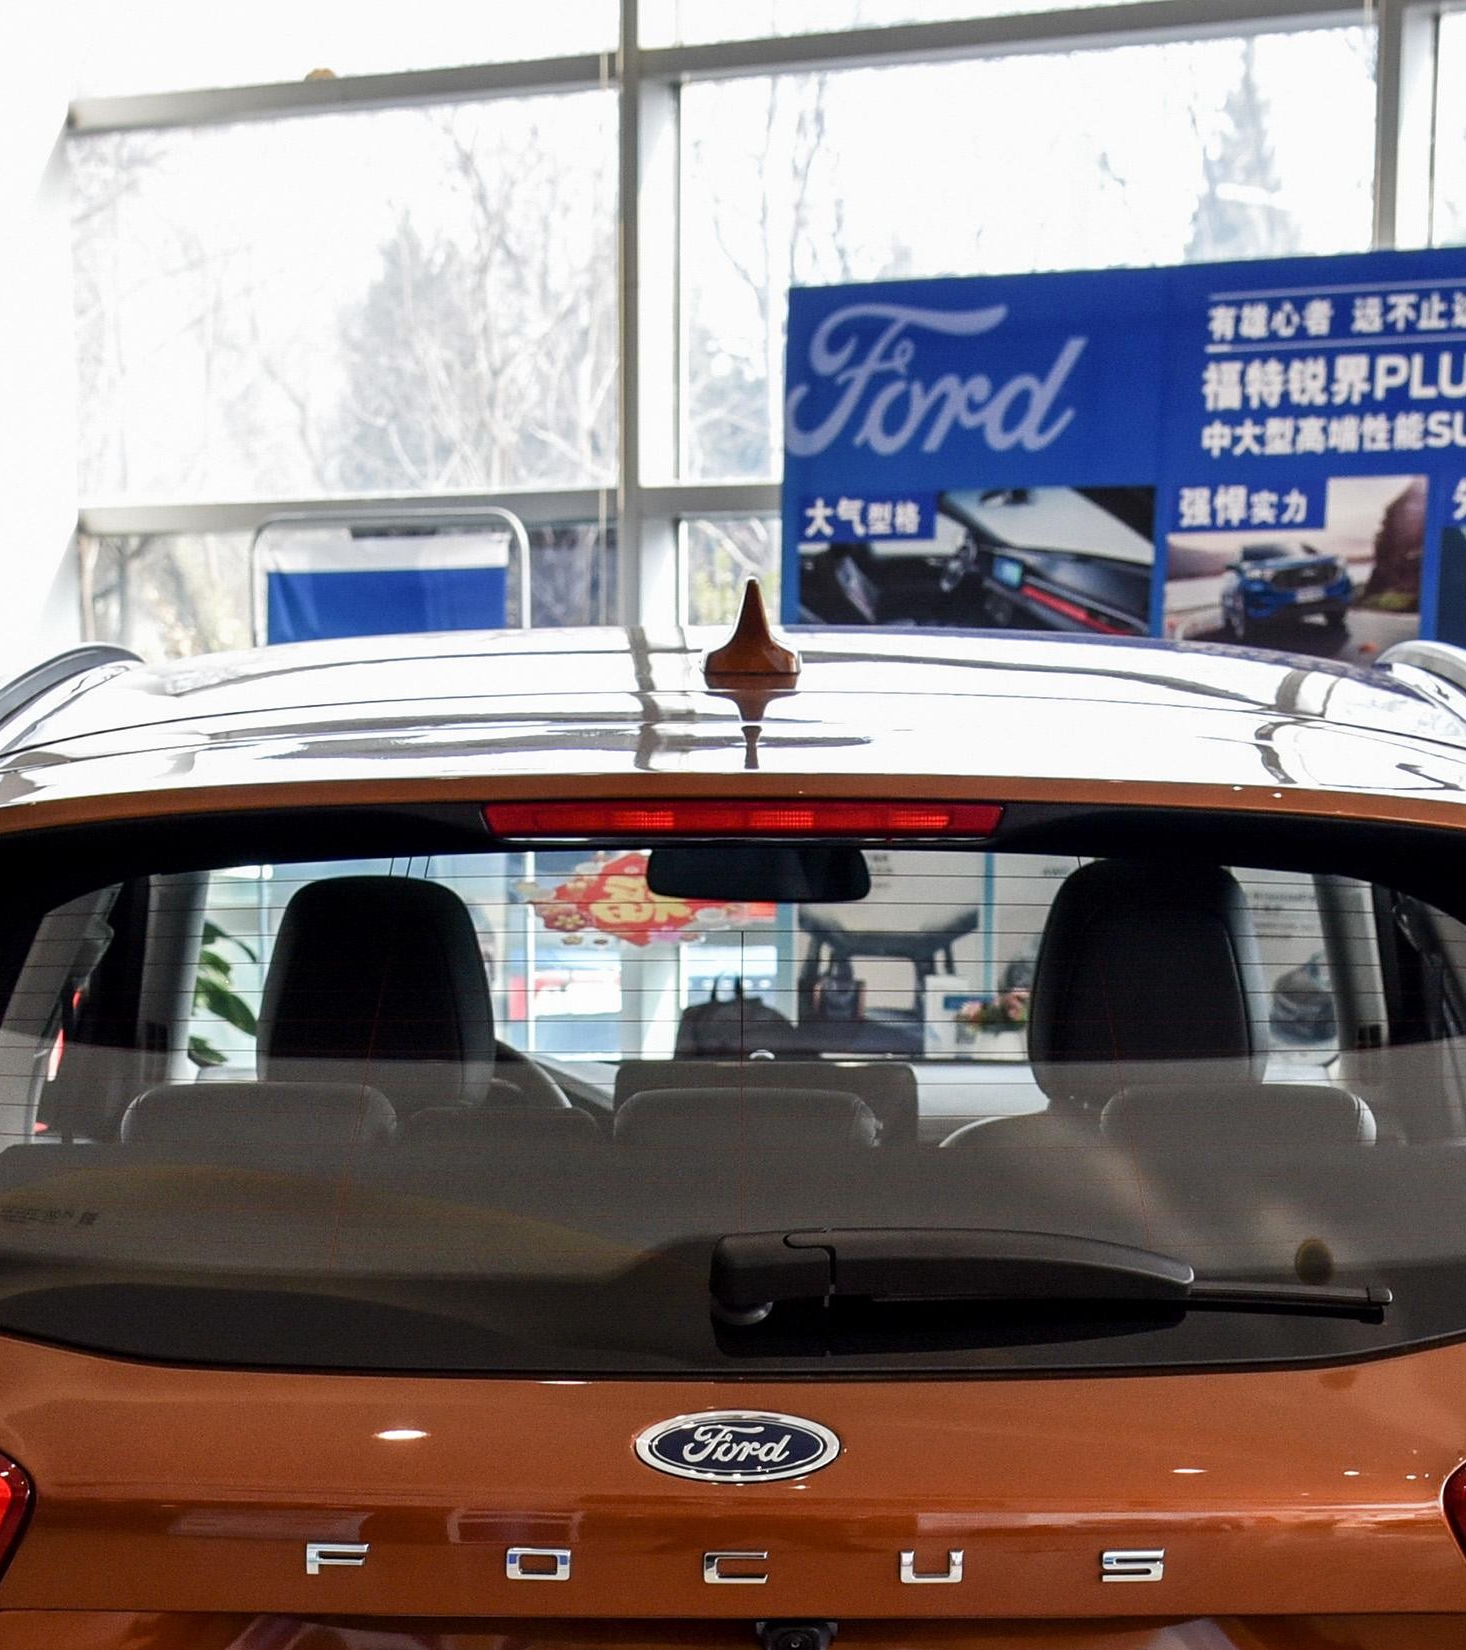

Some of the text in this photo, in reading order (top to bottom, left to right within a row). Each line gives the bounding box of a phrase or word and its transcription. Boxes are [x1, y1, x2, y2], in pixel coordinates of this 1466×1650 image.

[1209, 300, 1332, 341] 有雄心者
[786, 303, 1088, 456] Ford
[804, 497, 921, 539] 大气型格
[1180, 486, 1308, 528] 强悍实力
[683, 1424, 792, 1463] Ford
[304, 1541, 1166, 1586] FOCUS
